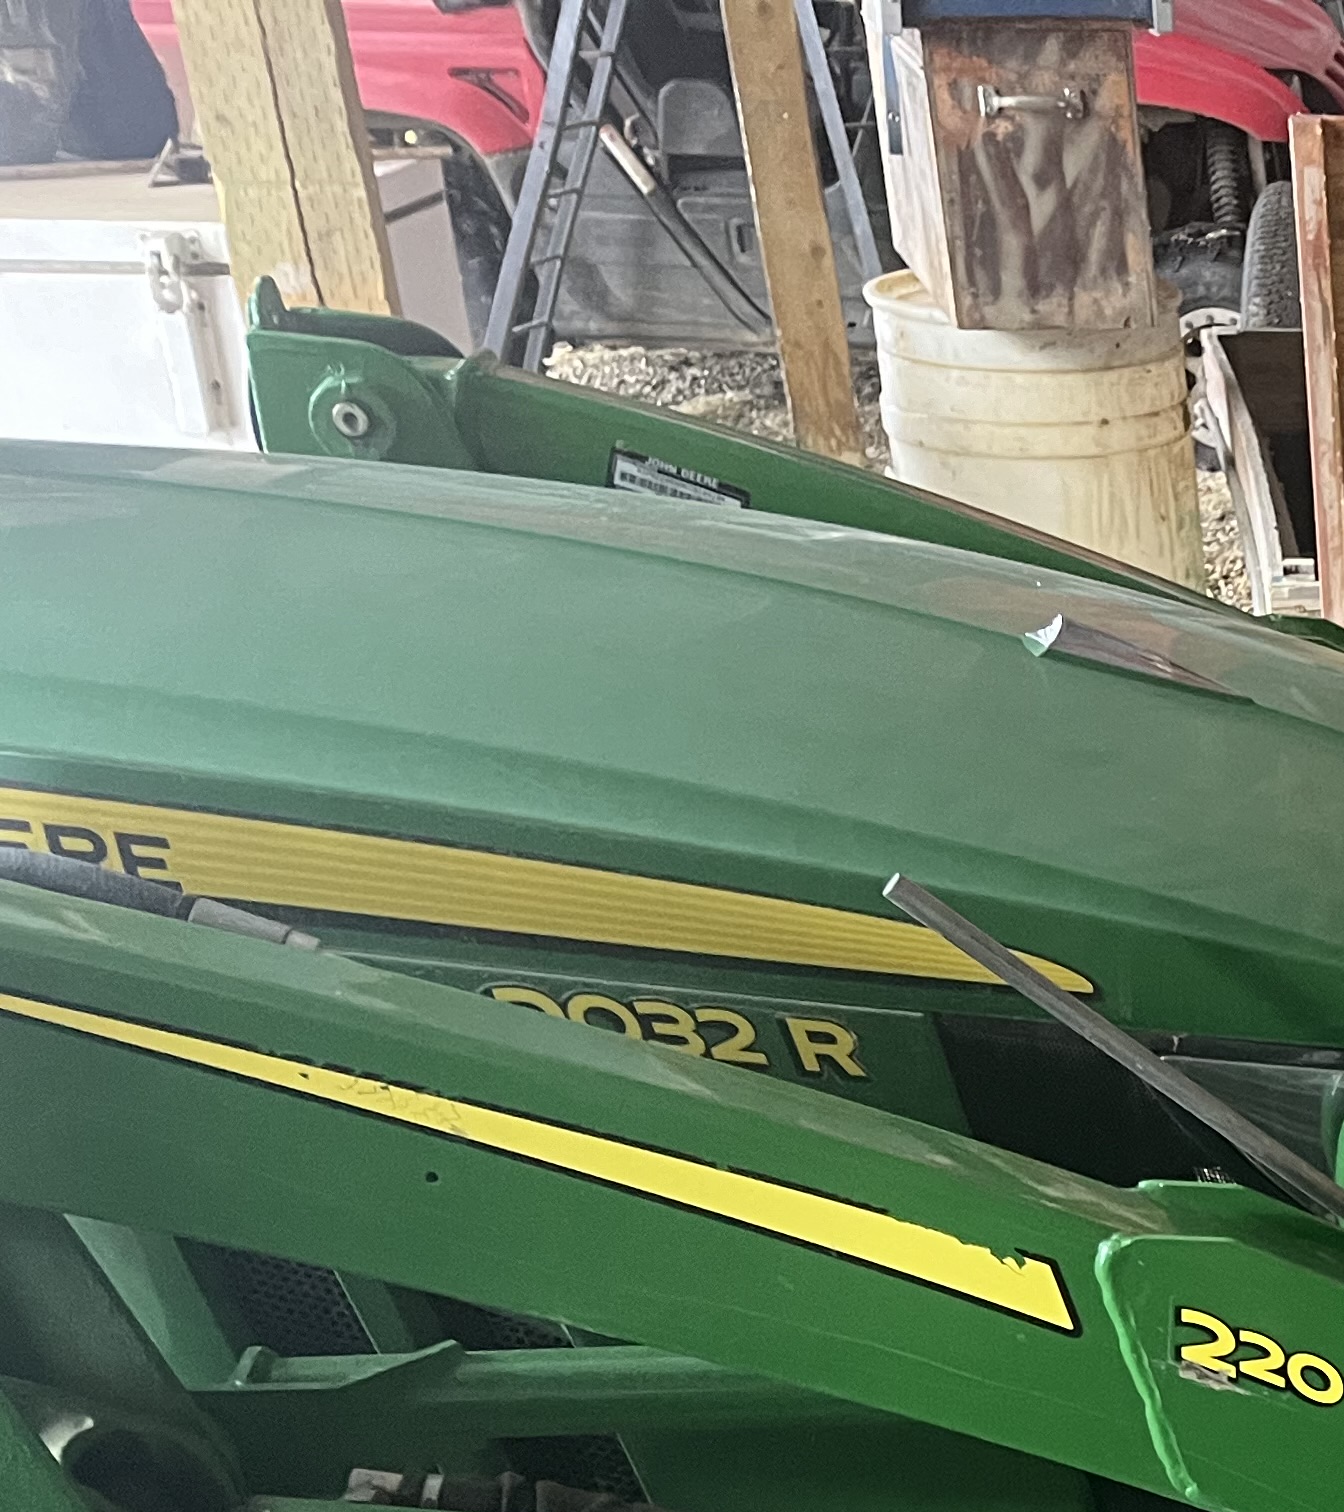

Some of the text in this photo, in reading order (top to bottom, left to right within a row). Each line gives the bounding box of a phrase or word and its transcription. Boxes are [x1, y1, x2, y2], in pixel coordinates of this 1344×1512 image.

[645, 456, 678, 475] JOHN
[680, 467, 720, 489] DEERE
[784, 1016, 868, 1079] R
[1178, 1307, 1344, 1405] 220
